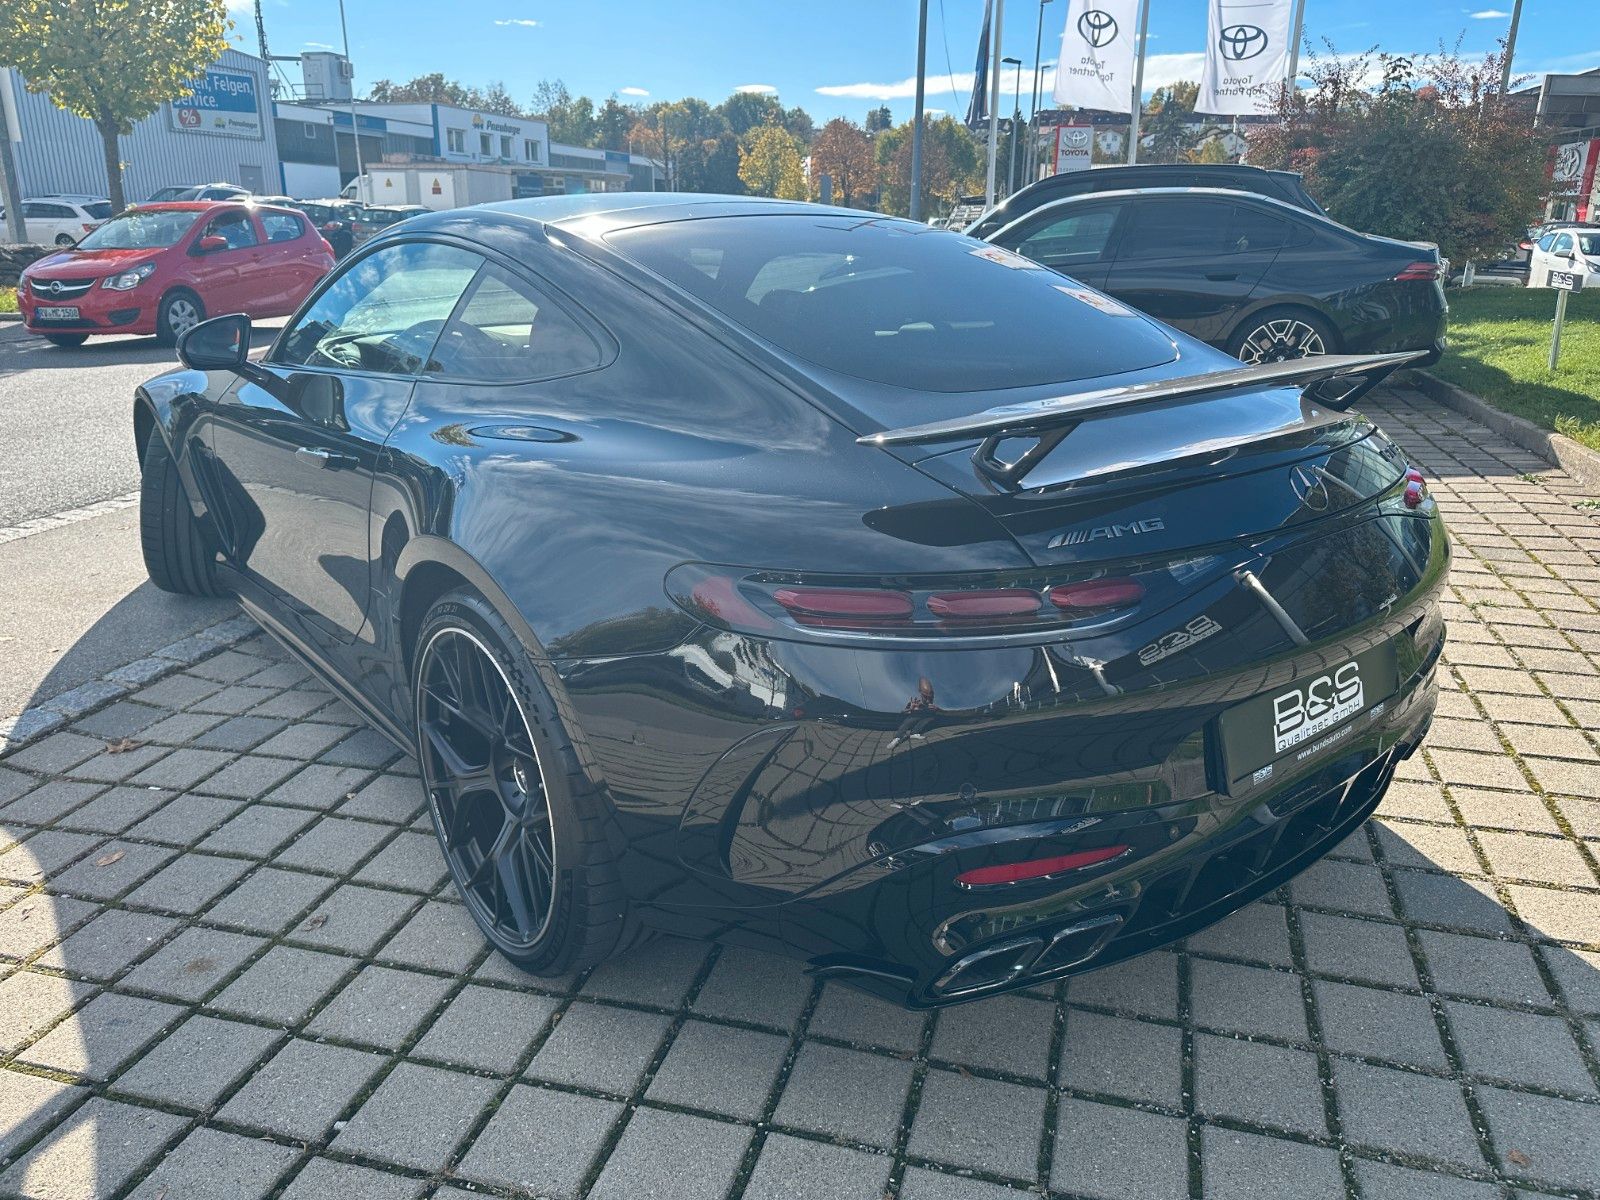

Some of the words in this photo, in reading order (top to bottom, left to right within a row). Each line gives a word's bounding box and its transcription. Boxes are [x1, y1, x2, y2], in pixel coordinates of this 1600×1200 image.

[214, 76, 253, 96] Felgen,
[486, 119, 521, 135] Pneuhage
[1061, 149, 1089, 157] TOYOTA
[1087, 517, 1165, 542] AMG
[1273, 661, 1361, 737] B&S
[1277, 717, 1329, 752] Qualitaet
[1332, 698, 1361, 723] GmbH
